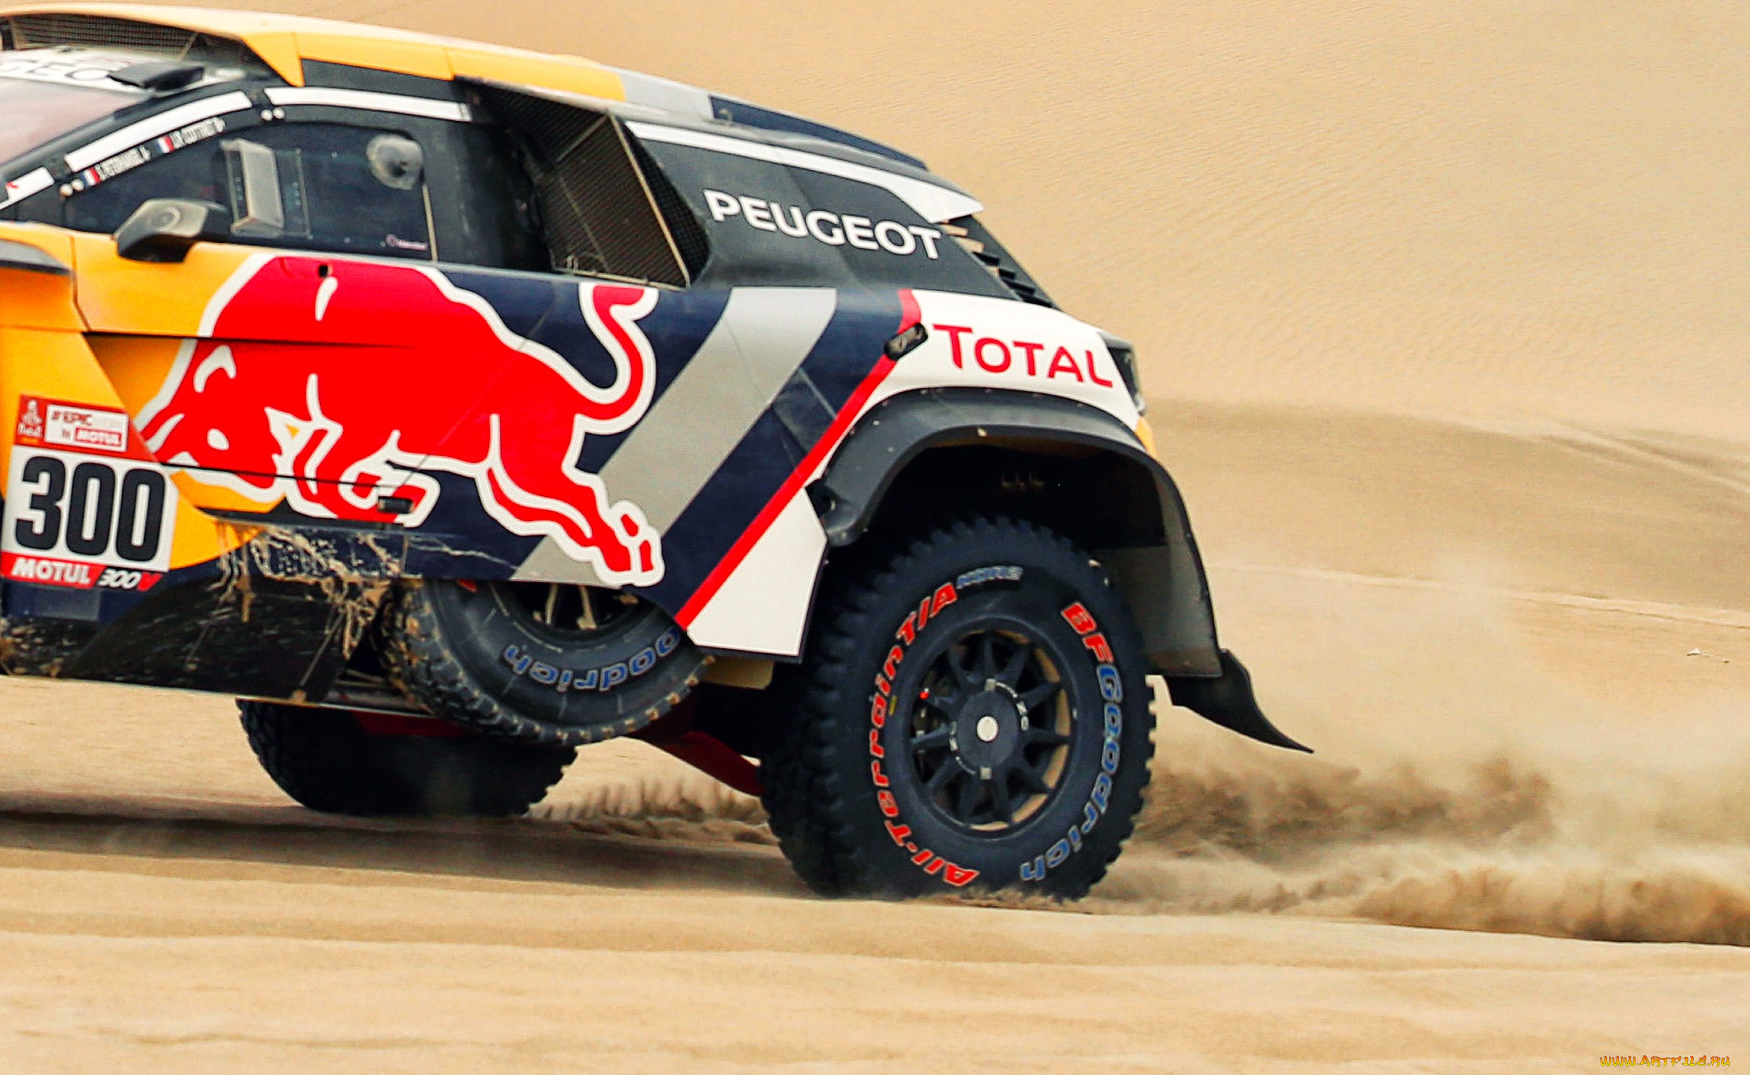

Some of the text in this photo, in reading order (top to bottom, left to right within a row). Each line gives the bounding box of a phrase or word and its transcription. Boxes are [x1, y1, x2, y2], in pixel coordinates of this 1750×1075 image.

[702, 189, 941, 260] PEUGEOT
[932, 323, 1113, 389] TOTAL
[14, 455, 167, 563] 300
[10, 558, 93, 586] MOTUL
[1019, 601, 1124, 883] BFGoodrich
